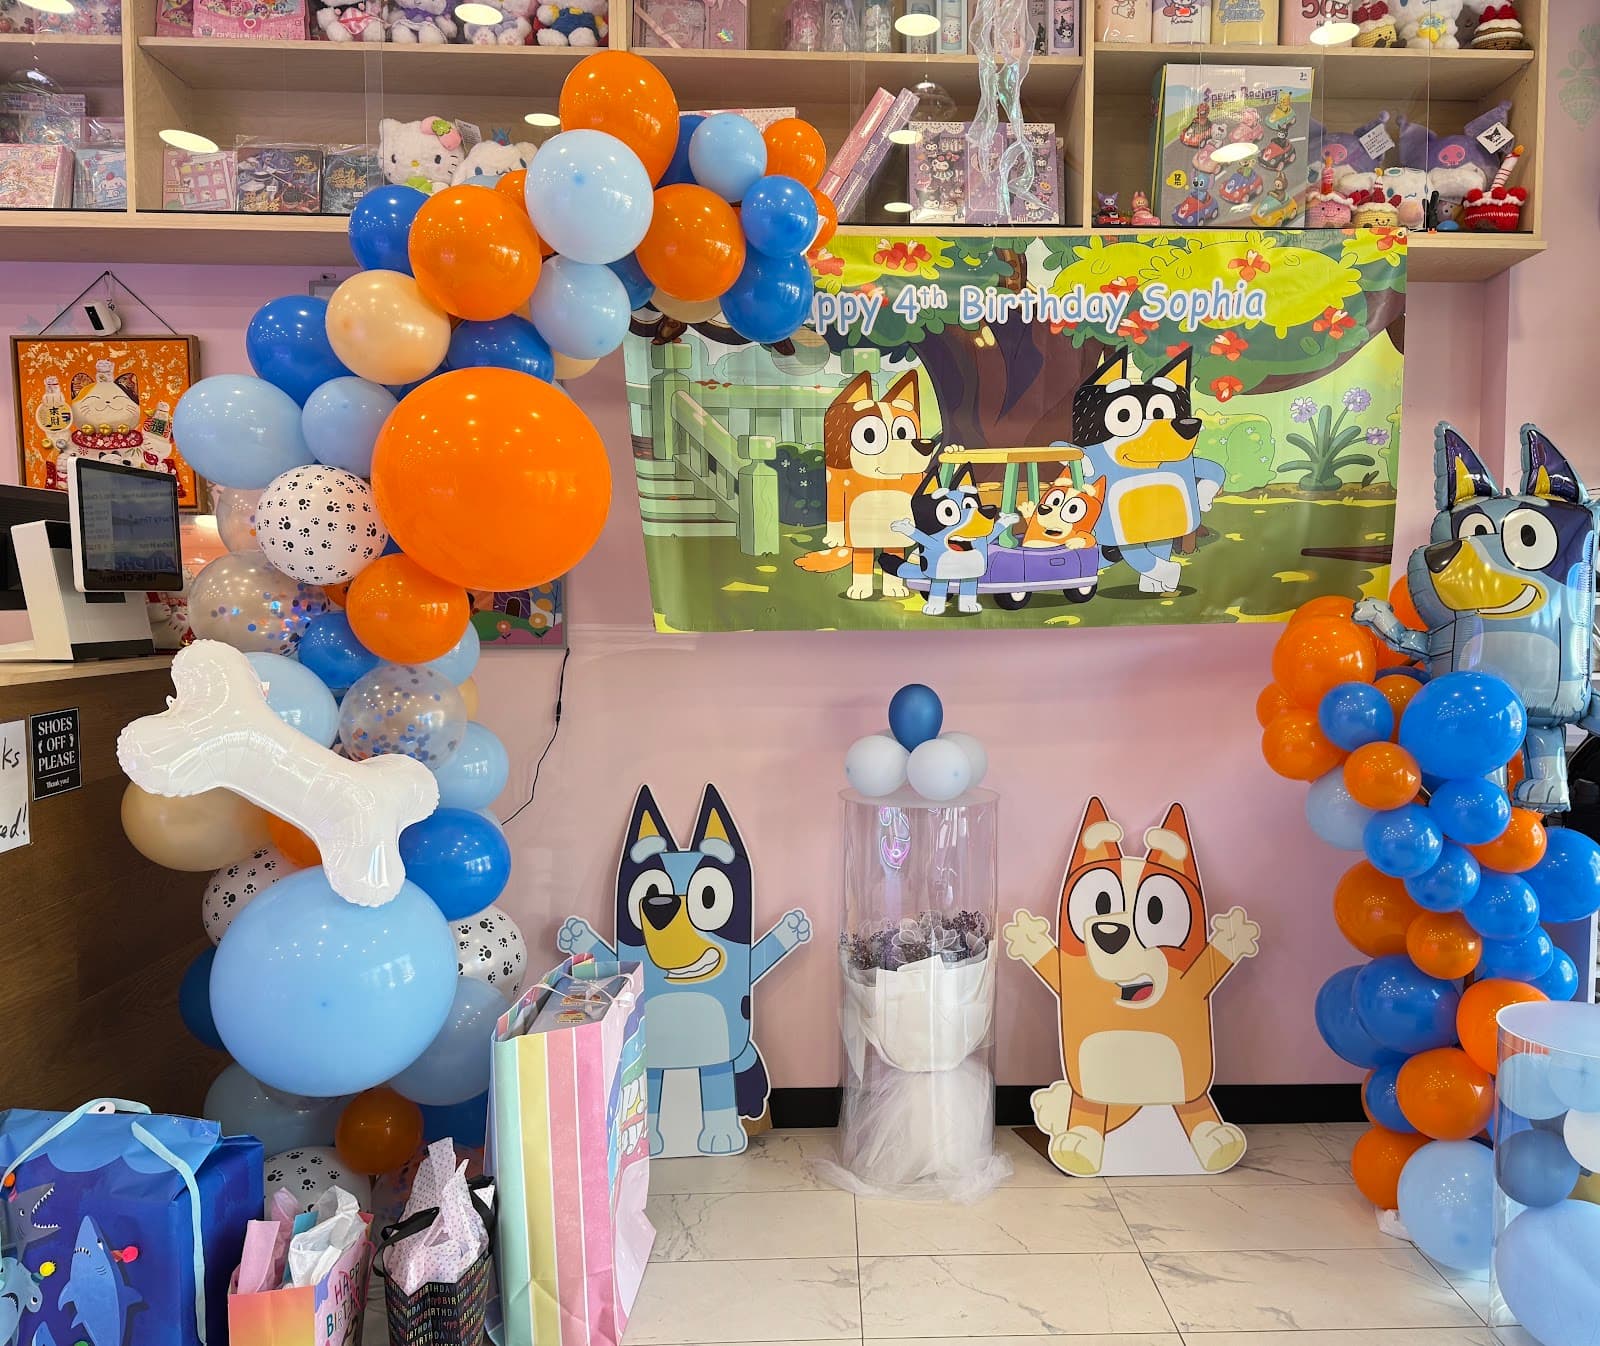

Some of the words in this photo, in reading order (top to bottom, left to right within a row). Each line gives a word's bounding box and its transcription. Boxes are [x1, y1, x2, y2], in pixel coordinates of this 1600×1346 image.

[810, 291, 882, 336] ppy
[892, 284, 948, 324] 4th
[960, 283, 1128, 333] Birthday
[1141, 278, 1265, 332] Sophia
[38, 716, 73, 736] SHOES
[46, 735, 66, 752] OFF
[38, 750, 76, 772] PLEASE
